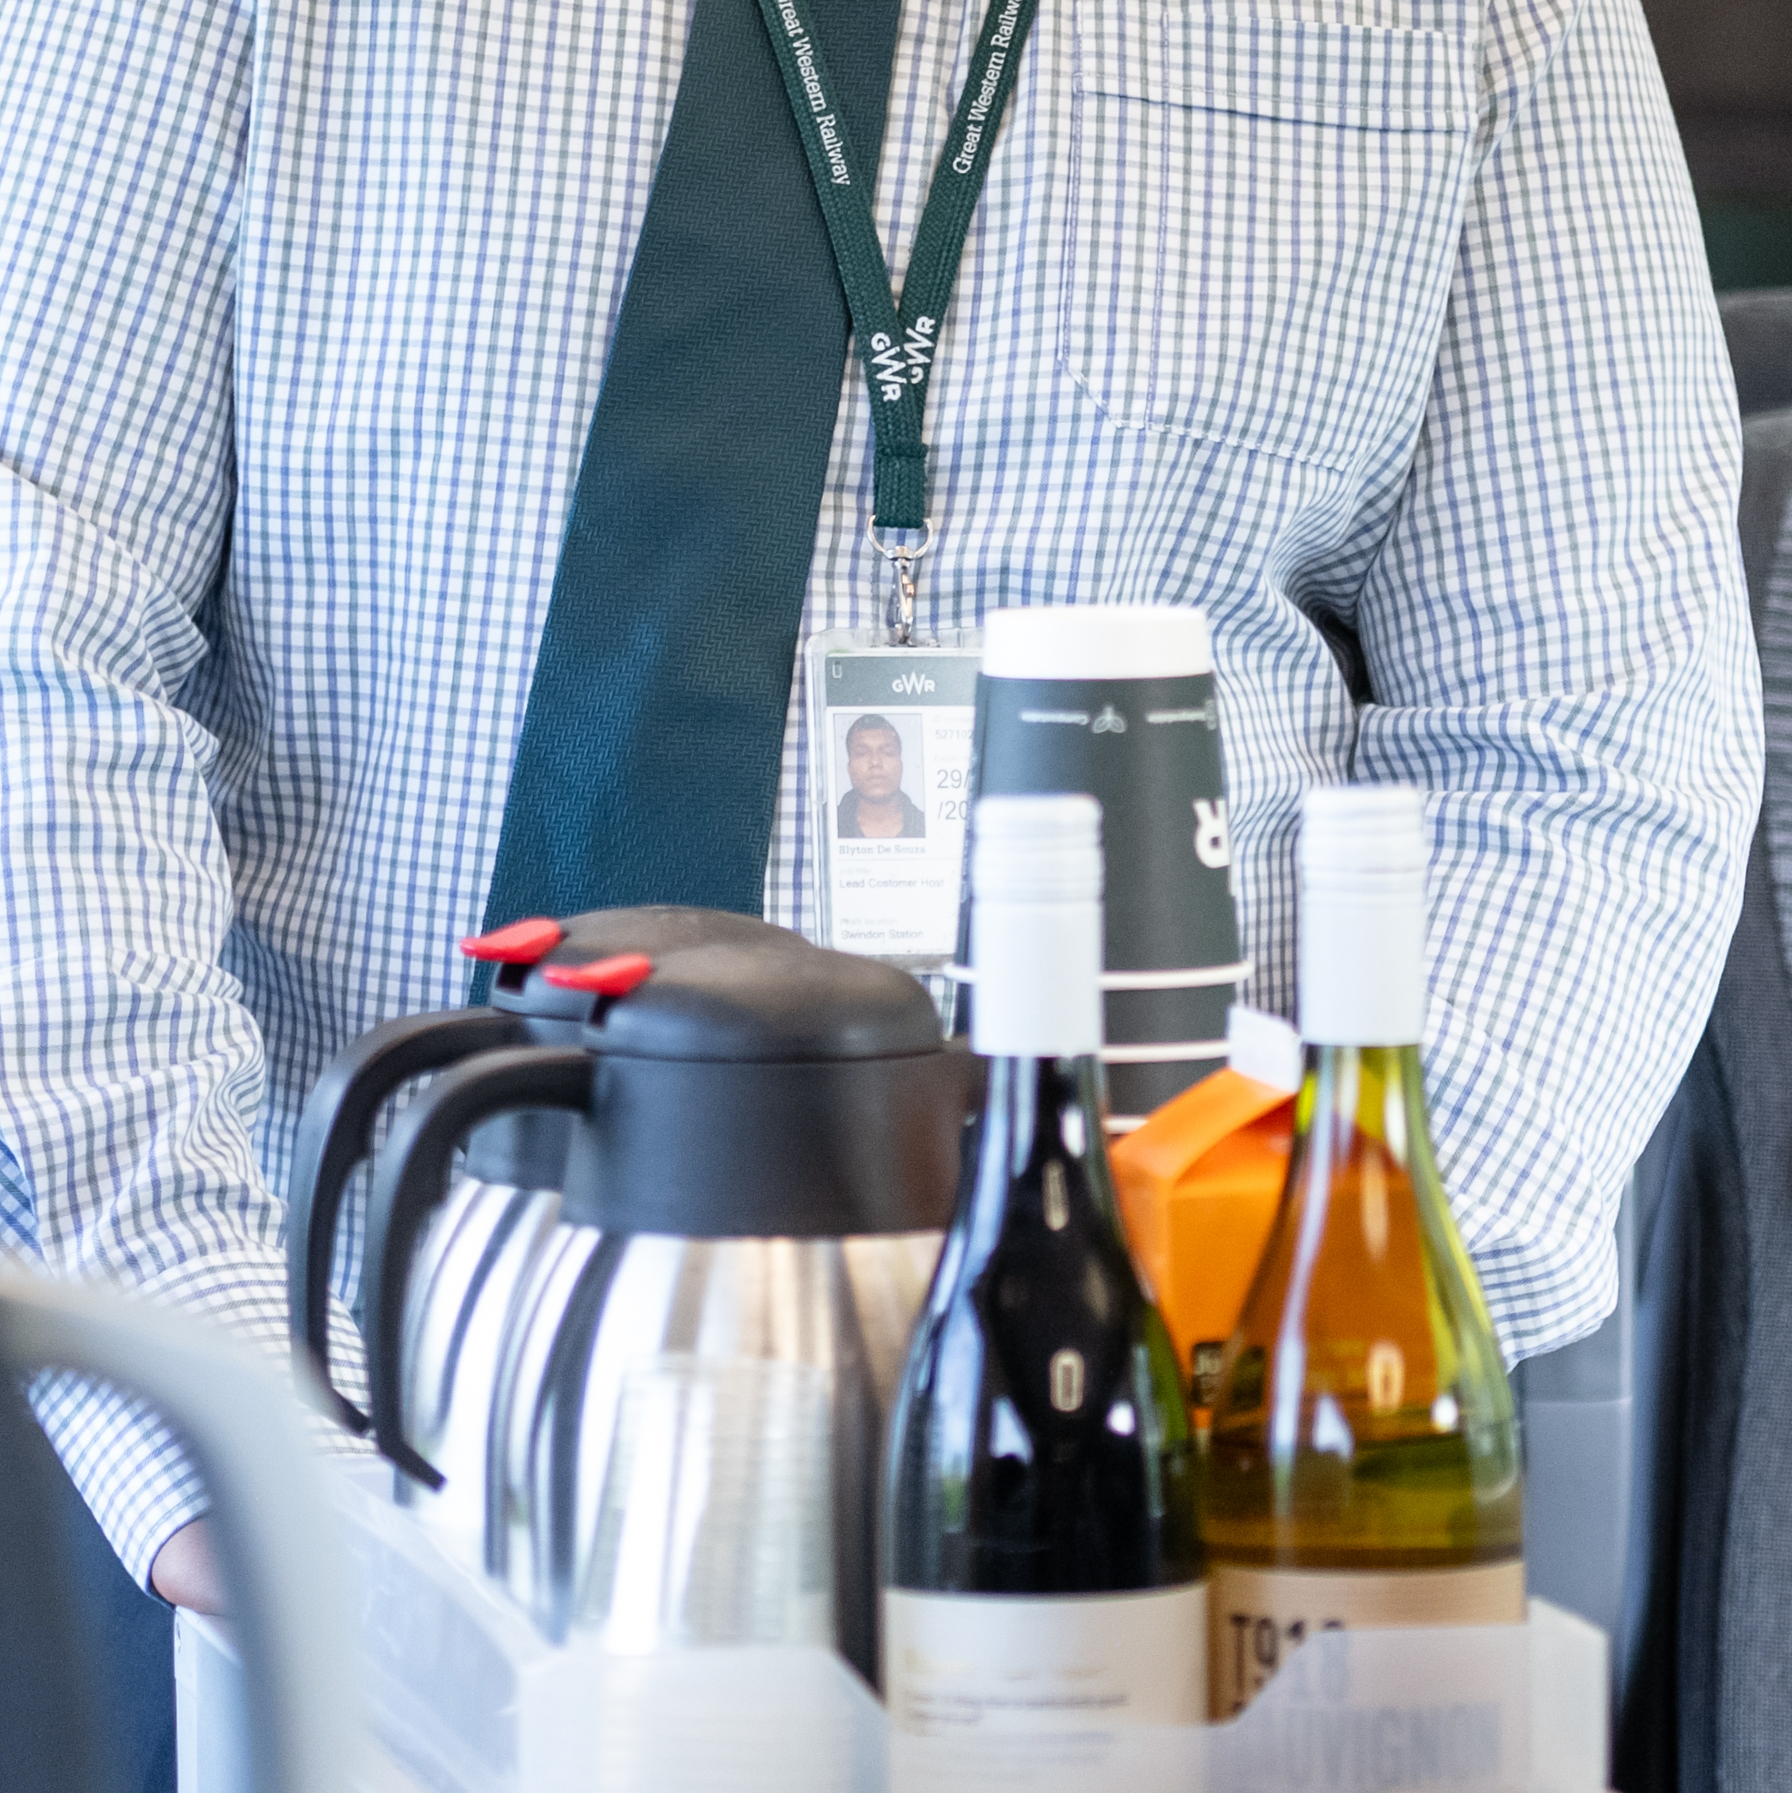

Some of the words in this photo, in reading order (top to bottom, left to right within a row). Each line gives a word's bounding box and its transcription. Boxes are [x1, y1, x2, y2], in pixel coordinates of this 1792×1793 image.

[792, 36, 828, 113] Western
[816, 113, 851, 186] Railway
[952, 122, 983, 175] Great
[968, 51, 1007, 123] Western
[871, 332, 907, 402] GWR
[903, 316, 936, 384] GWR
[891, 671, 936, 695] GWR
[839, 845, 874, 856] Blyton
[877, 844, 891, 855] De
[894, 844, 926, 854] Souza
[839, 878, 865, 888] Lead
[921, 878, 944, 888] Host
[841, 929, 885, 940] Swindon
[888, 929, 924, 939] Station
